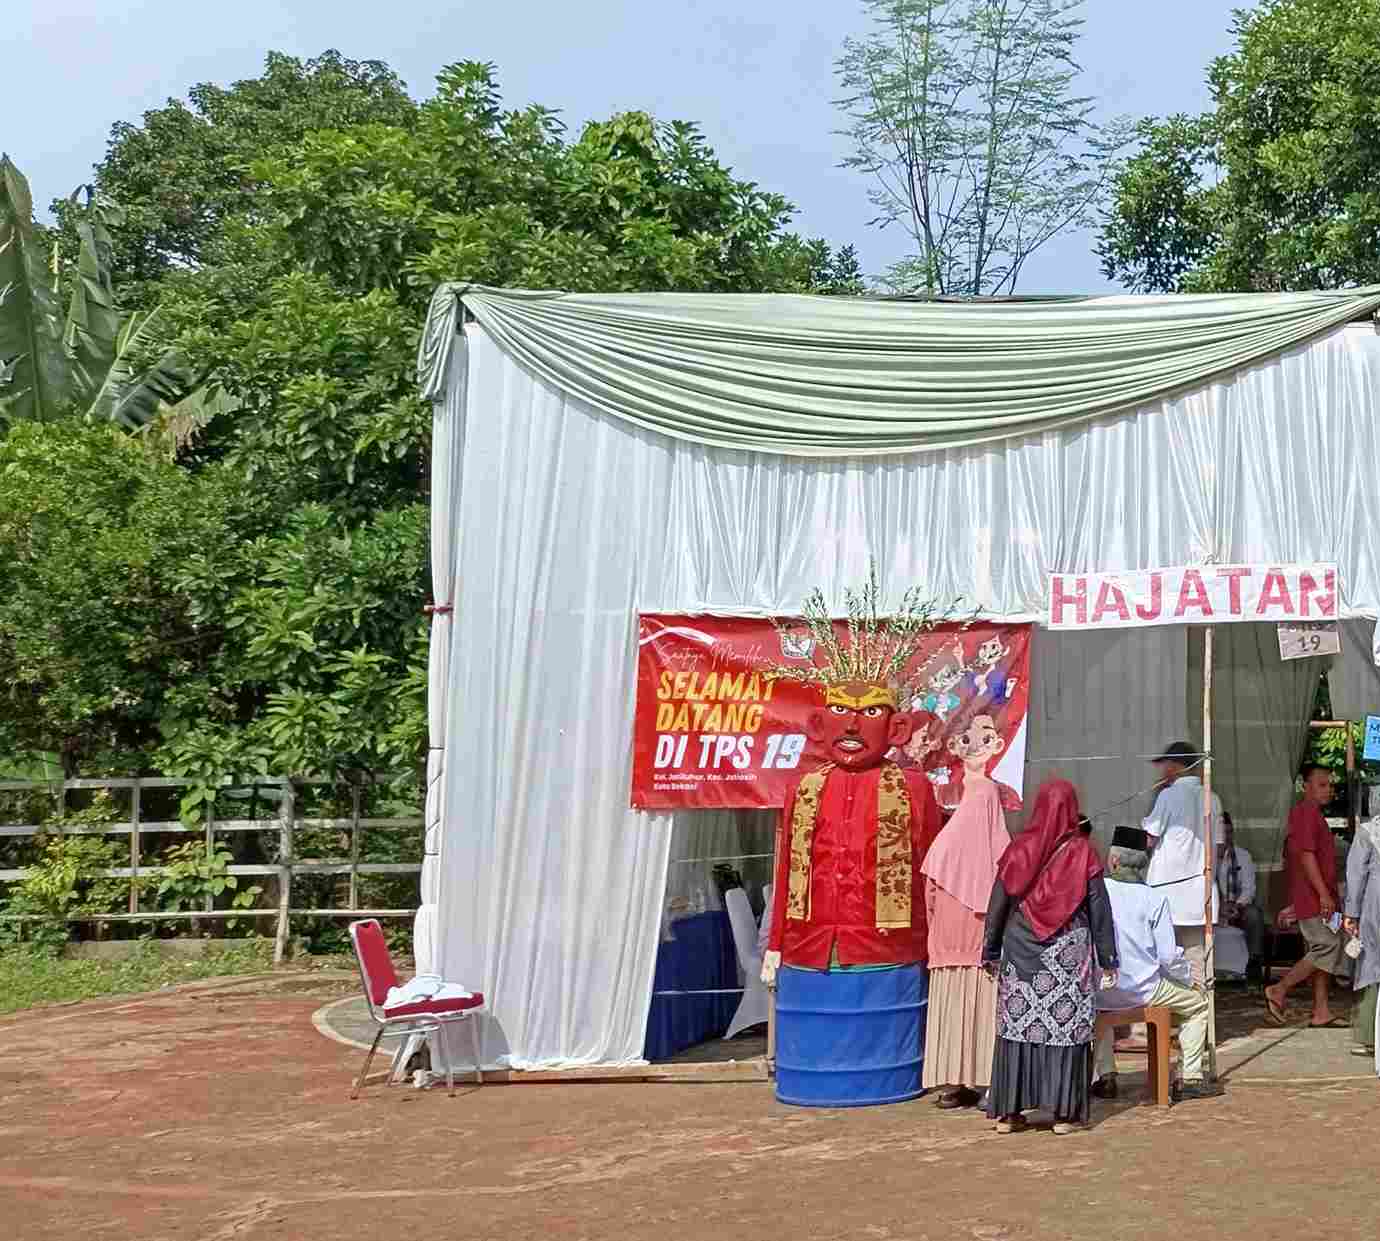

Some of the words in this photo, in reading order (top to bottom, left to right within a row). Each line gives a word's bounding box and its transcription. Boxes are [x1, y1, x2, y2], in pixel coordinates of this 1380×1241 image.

[1051, 567, 1337, 624] HAJATAN
[1297, 634, 1321, 651] 19
[656, 671, 776, 701] SELAMAT
[655, 703, 765, 733] DATANG
[654, 734, 689, 769] DI
[698, 734, 754, 769] TPS
[761, 734, 807, 769] 19
